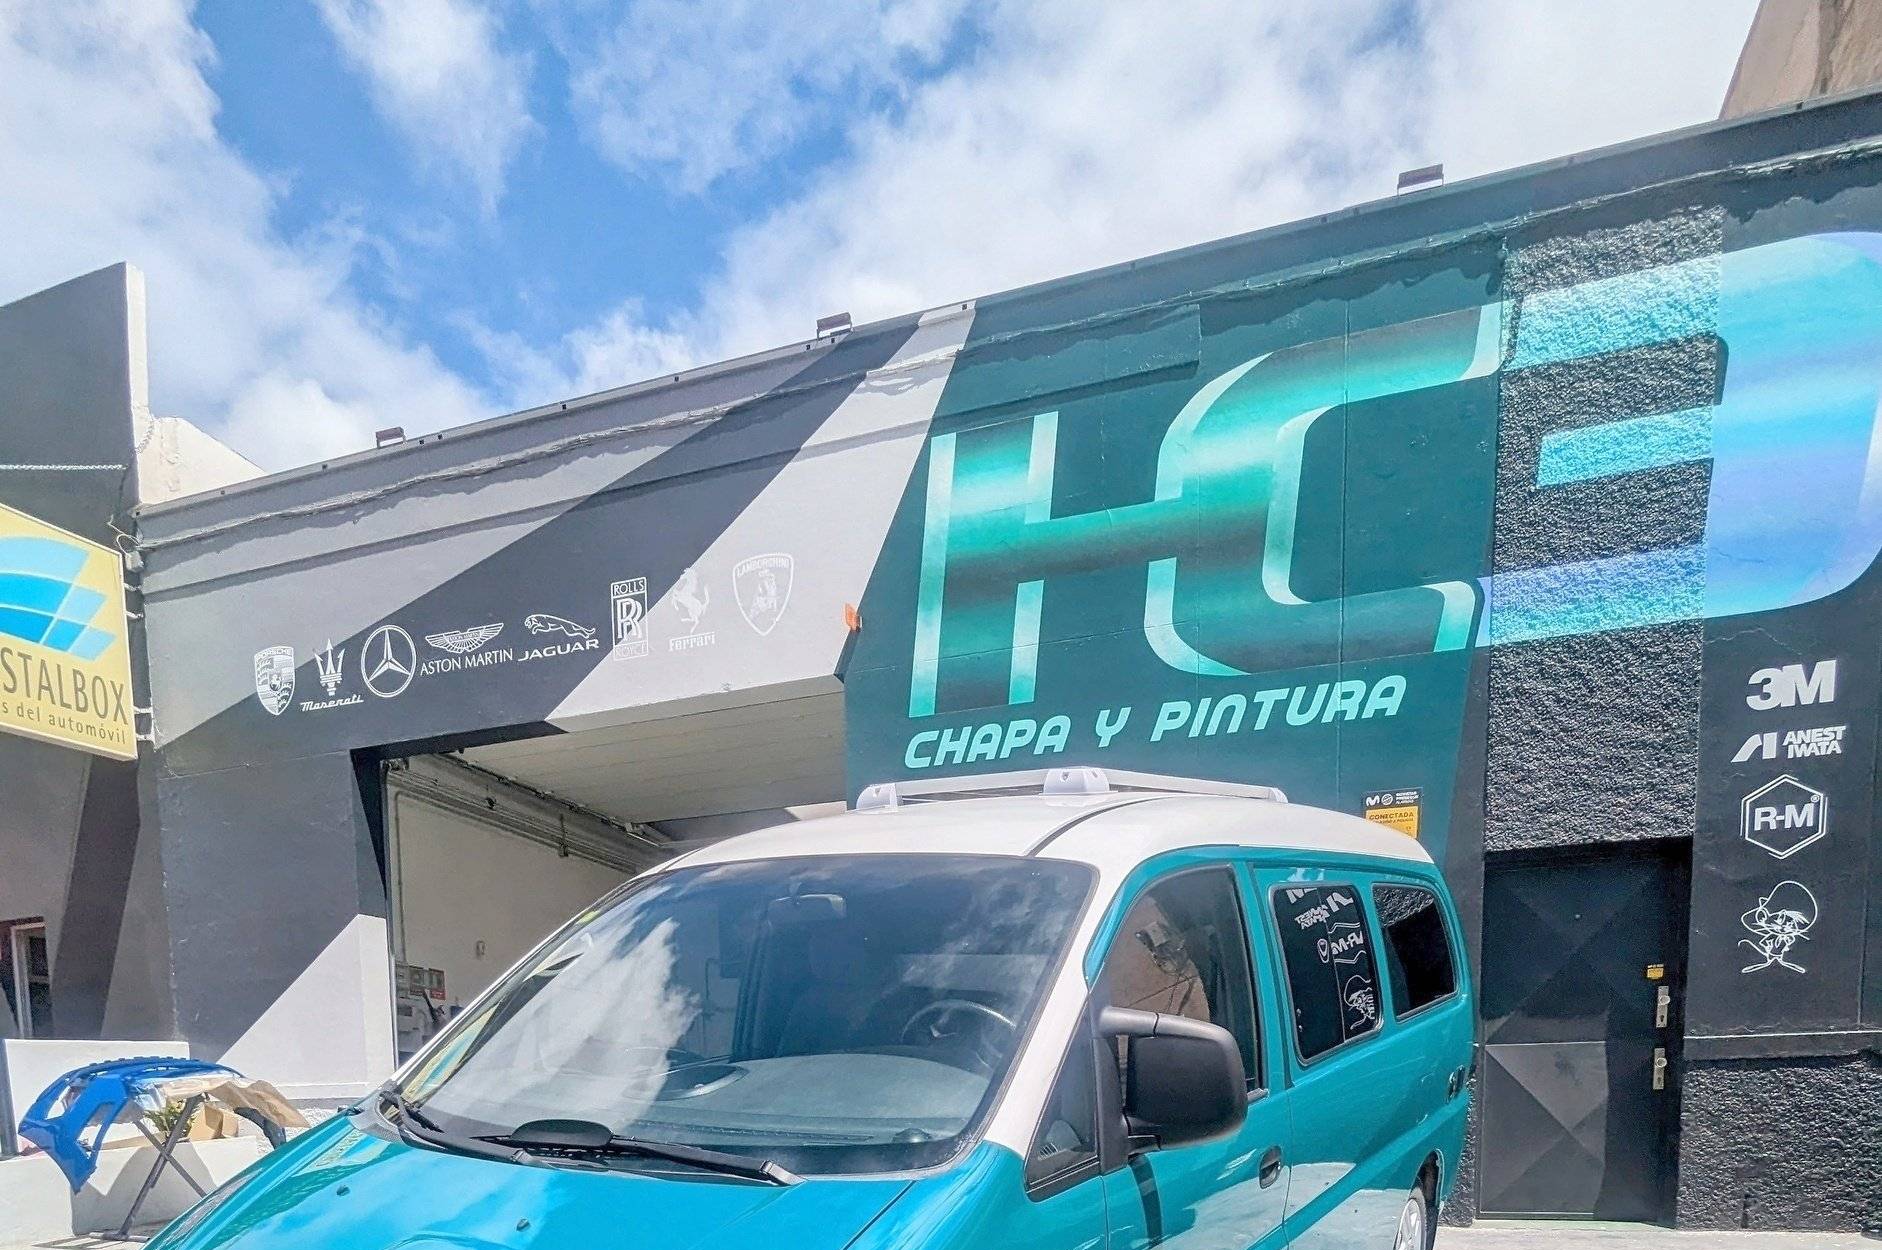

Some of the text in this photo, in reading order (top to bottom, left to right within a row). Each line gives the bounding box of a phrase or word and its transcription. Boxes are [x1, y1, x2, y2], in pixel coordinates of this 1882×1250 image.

[614, 580, 644, 595] ROLLS
[518, 639, 600, 661] JAGUAR
[419, 648, 513, 676] ASTON MARTIN
[1746, 659, 1836, 711] 3M
[300, 693, 364, 712] Maserati
[17, 702, 40, 721] del
[48, 713, 125, 744] automóvil
[905, 675, 1408, 769] CHAPA Y PINTURA
[1782, 726, 1847, 746] ANEST
[1788, 740, 1842, 759] IWATA
